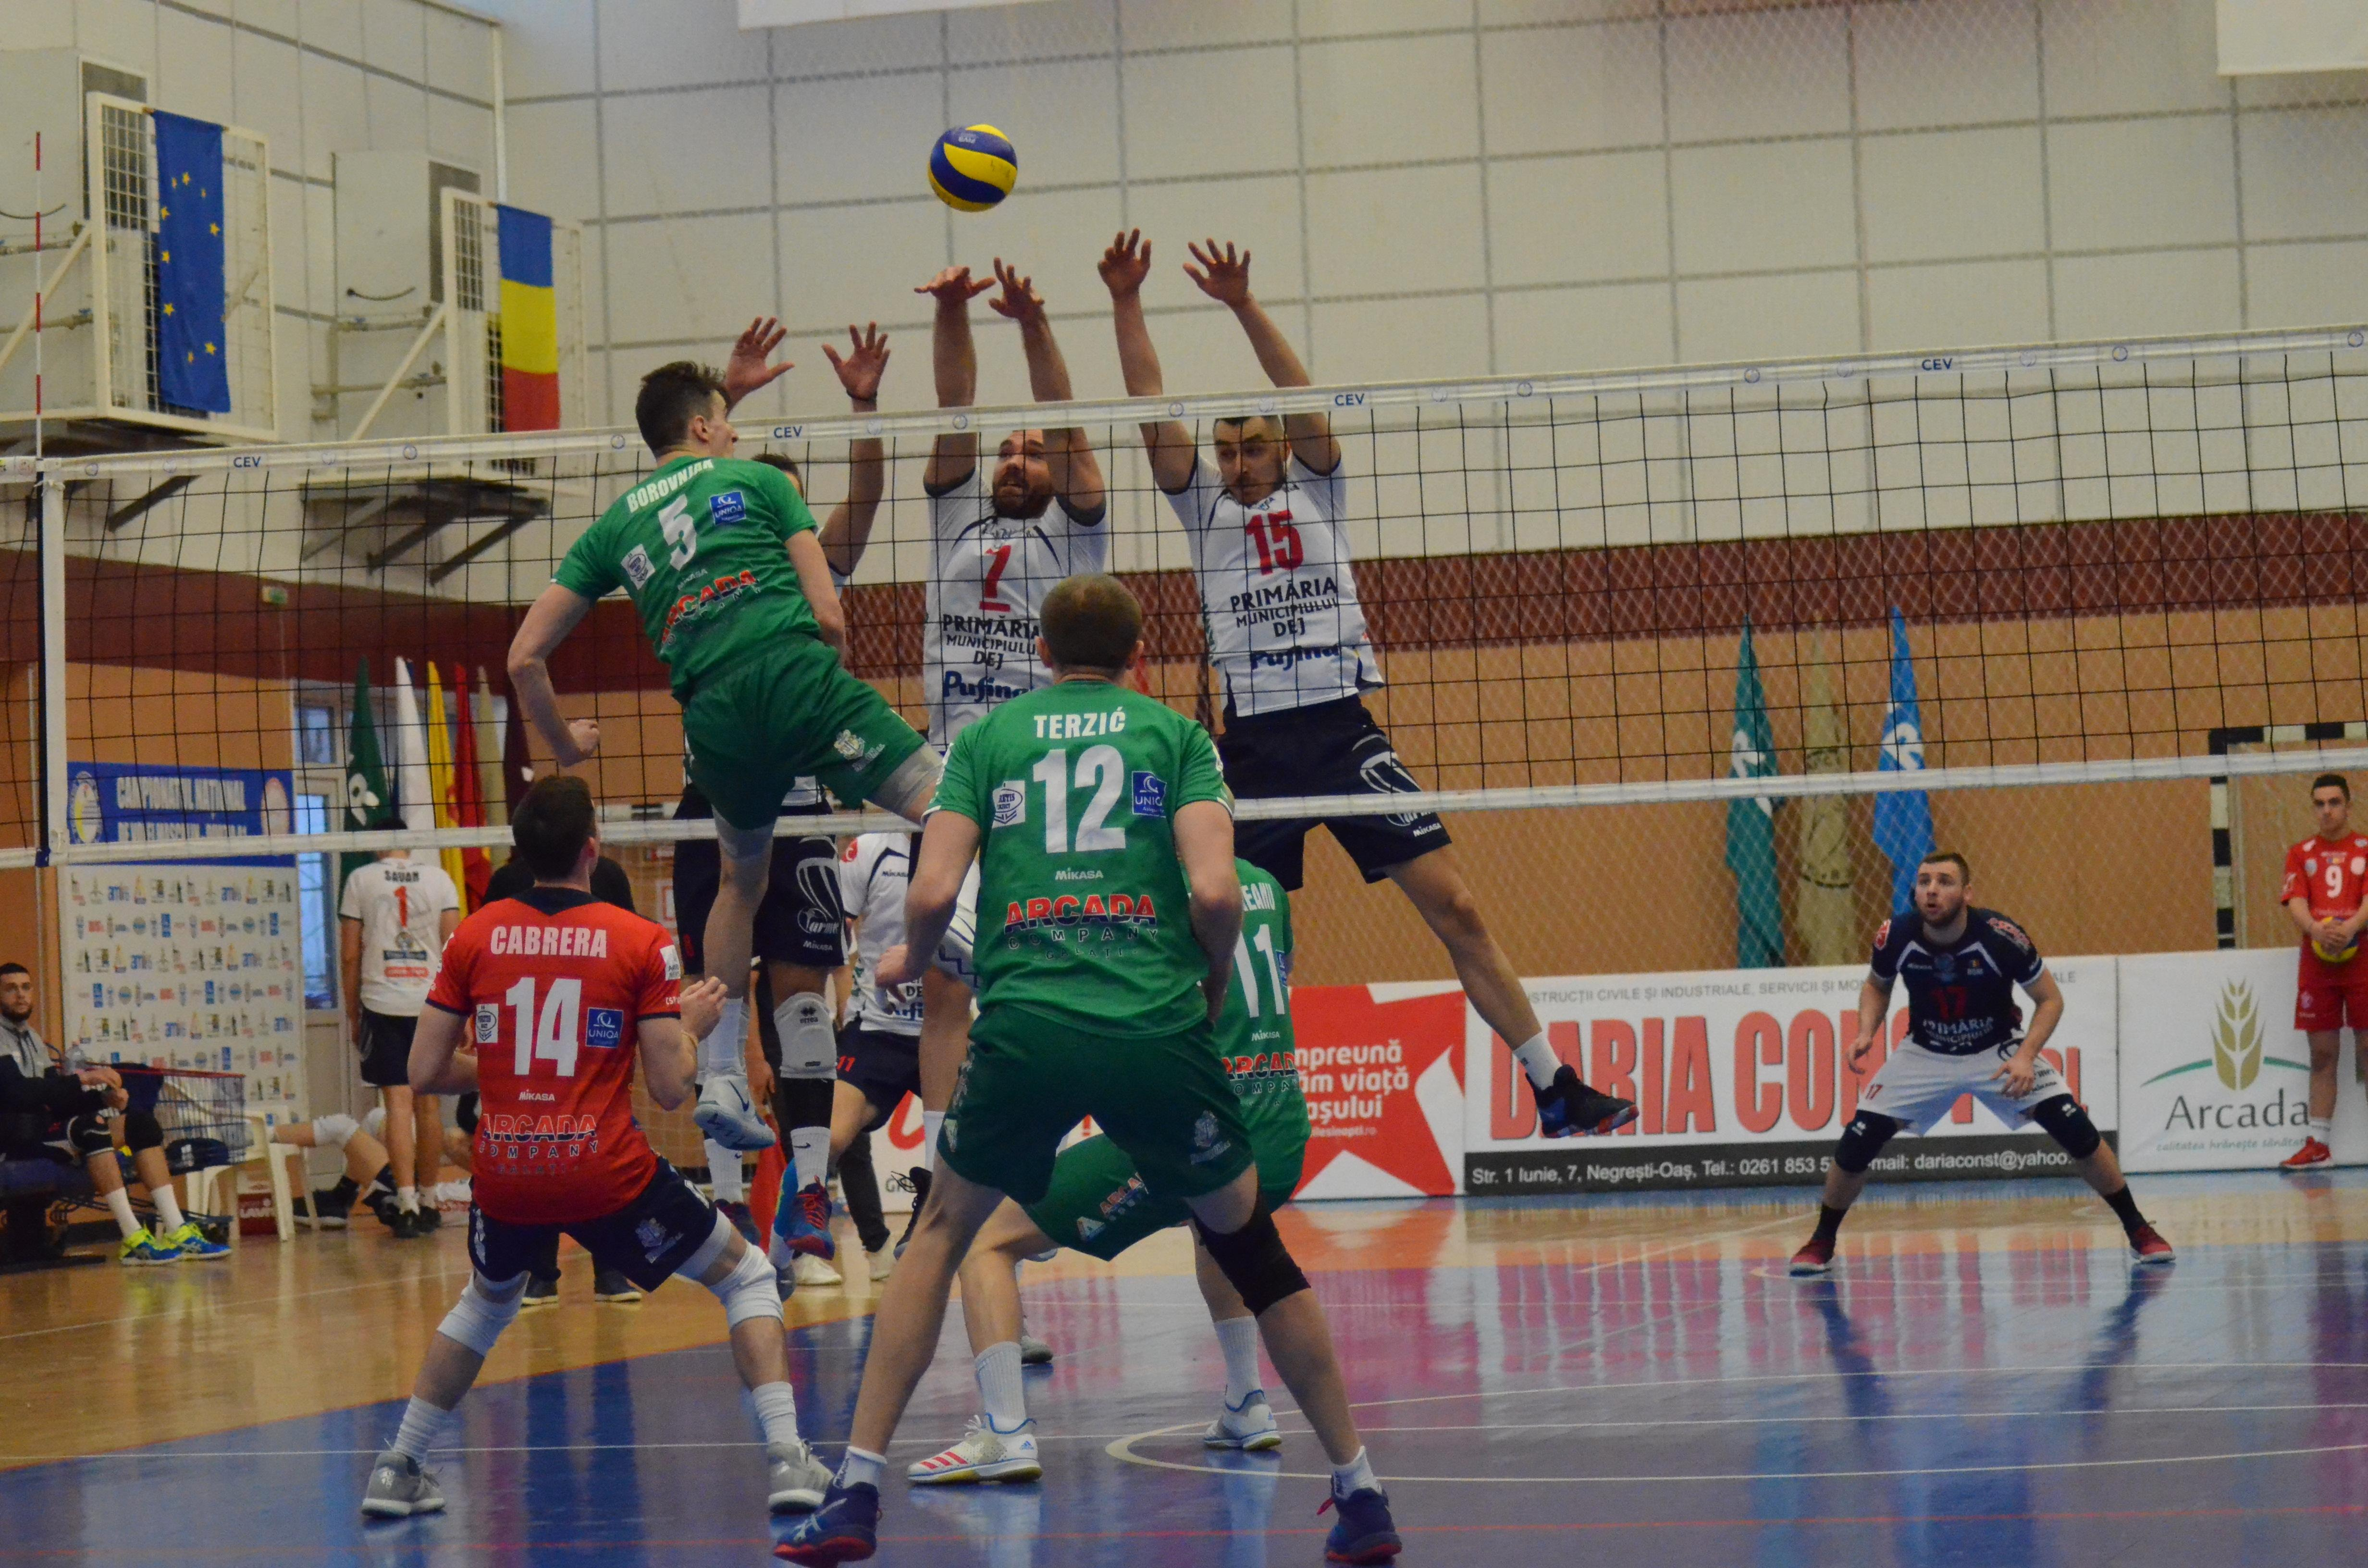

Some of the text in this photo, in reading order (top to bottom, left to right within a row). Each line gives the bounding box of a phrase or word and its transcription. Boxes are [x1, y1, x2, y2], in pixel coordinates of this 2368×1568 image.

[1922, 358, 1952, 371] CEV
[1334, 393, 1365, 406] CEV
[774, 427, 802, 438] CEV
[234, 456, 261, 468] CEV
[658, 494, 697, 571] 5
[1246, 510, 1304, 576] 15
[1273, 618, 1306, 637] DEJ
[974, 650, 1004, 670] DEJ
[1034, 706, 1126, 739] TERZIĆ
[1033, 744, 1126, 854] 12
[2325, 865, 2343, 898] 9
[394, 885, 408, 928] 1
[1004, 894, 1157, 934] ARCADA
[490, 926, 607, 958] CABRERA
[1008, 926, 1159, 949] COMPANY
[1233, 924, 1285, 1018] 11
[1597, 988, 1640, 1001] CIVILE
[1759, 981, 1818, 995] SERVICII
[1932, 985, 1967, 1022] 17
[506, 977, 582, 1077] 14
[589, 1029, 619, 1039] UNIQA
[1294, 1039, 1402, 1072] mpreună
[1299, 1065, 1409, 1095] ăm viață
[1490, 1015, 1716, 1140] DARIA
[1306, 1094, 1383, 1125] așului
[2165, 1087, 2309, 1130] Arcada
[1472, 1168, 1499, 1185] Str.
[1504, 1168, 1513, 1183] 1
[1739, 1158, 1779, 1176] 0261
[1784, 1156, 1816, 1174] 853
